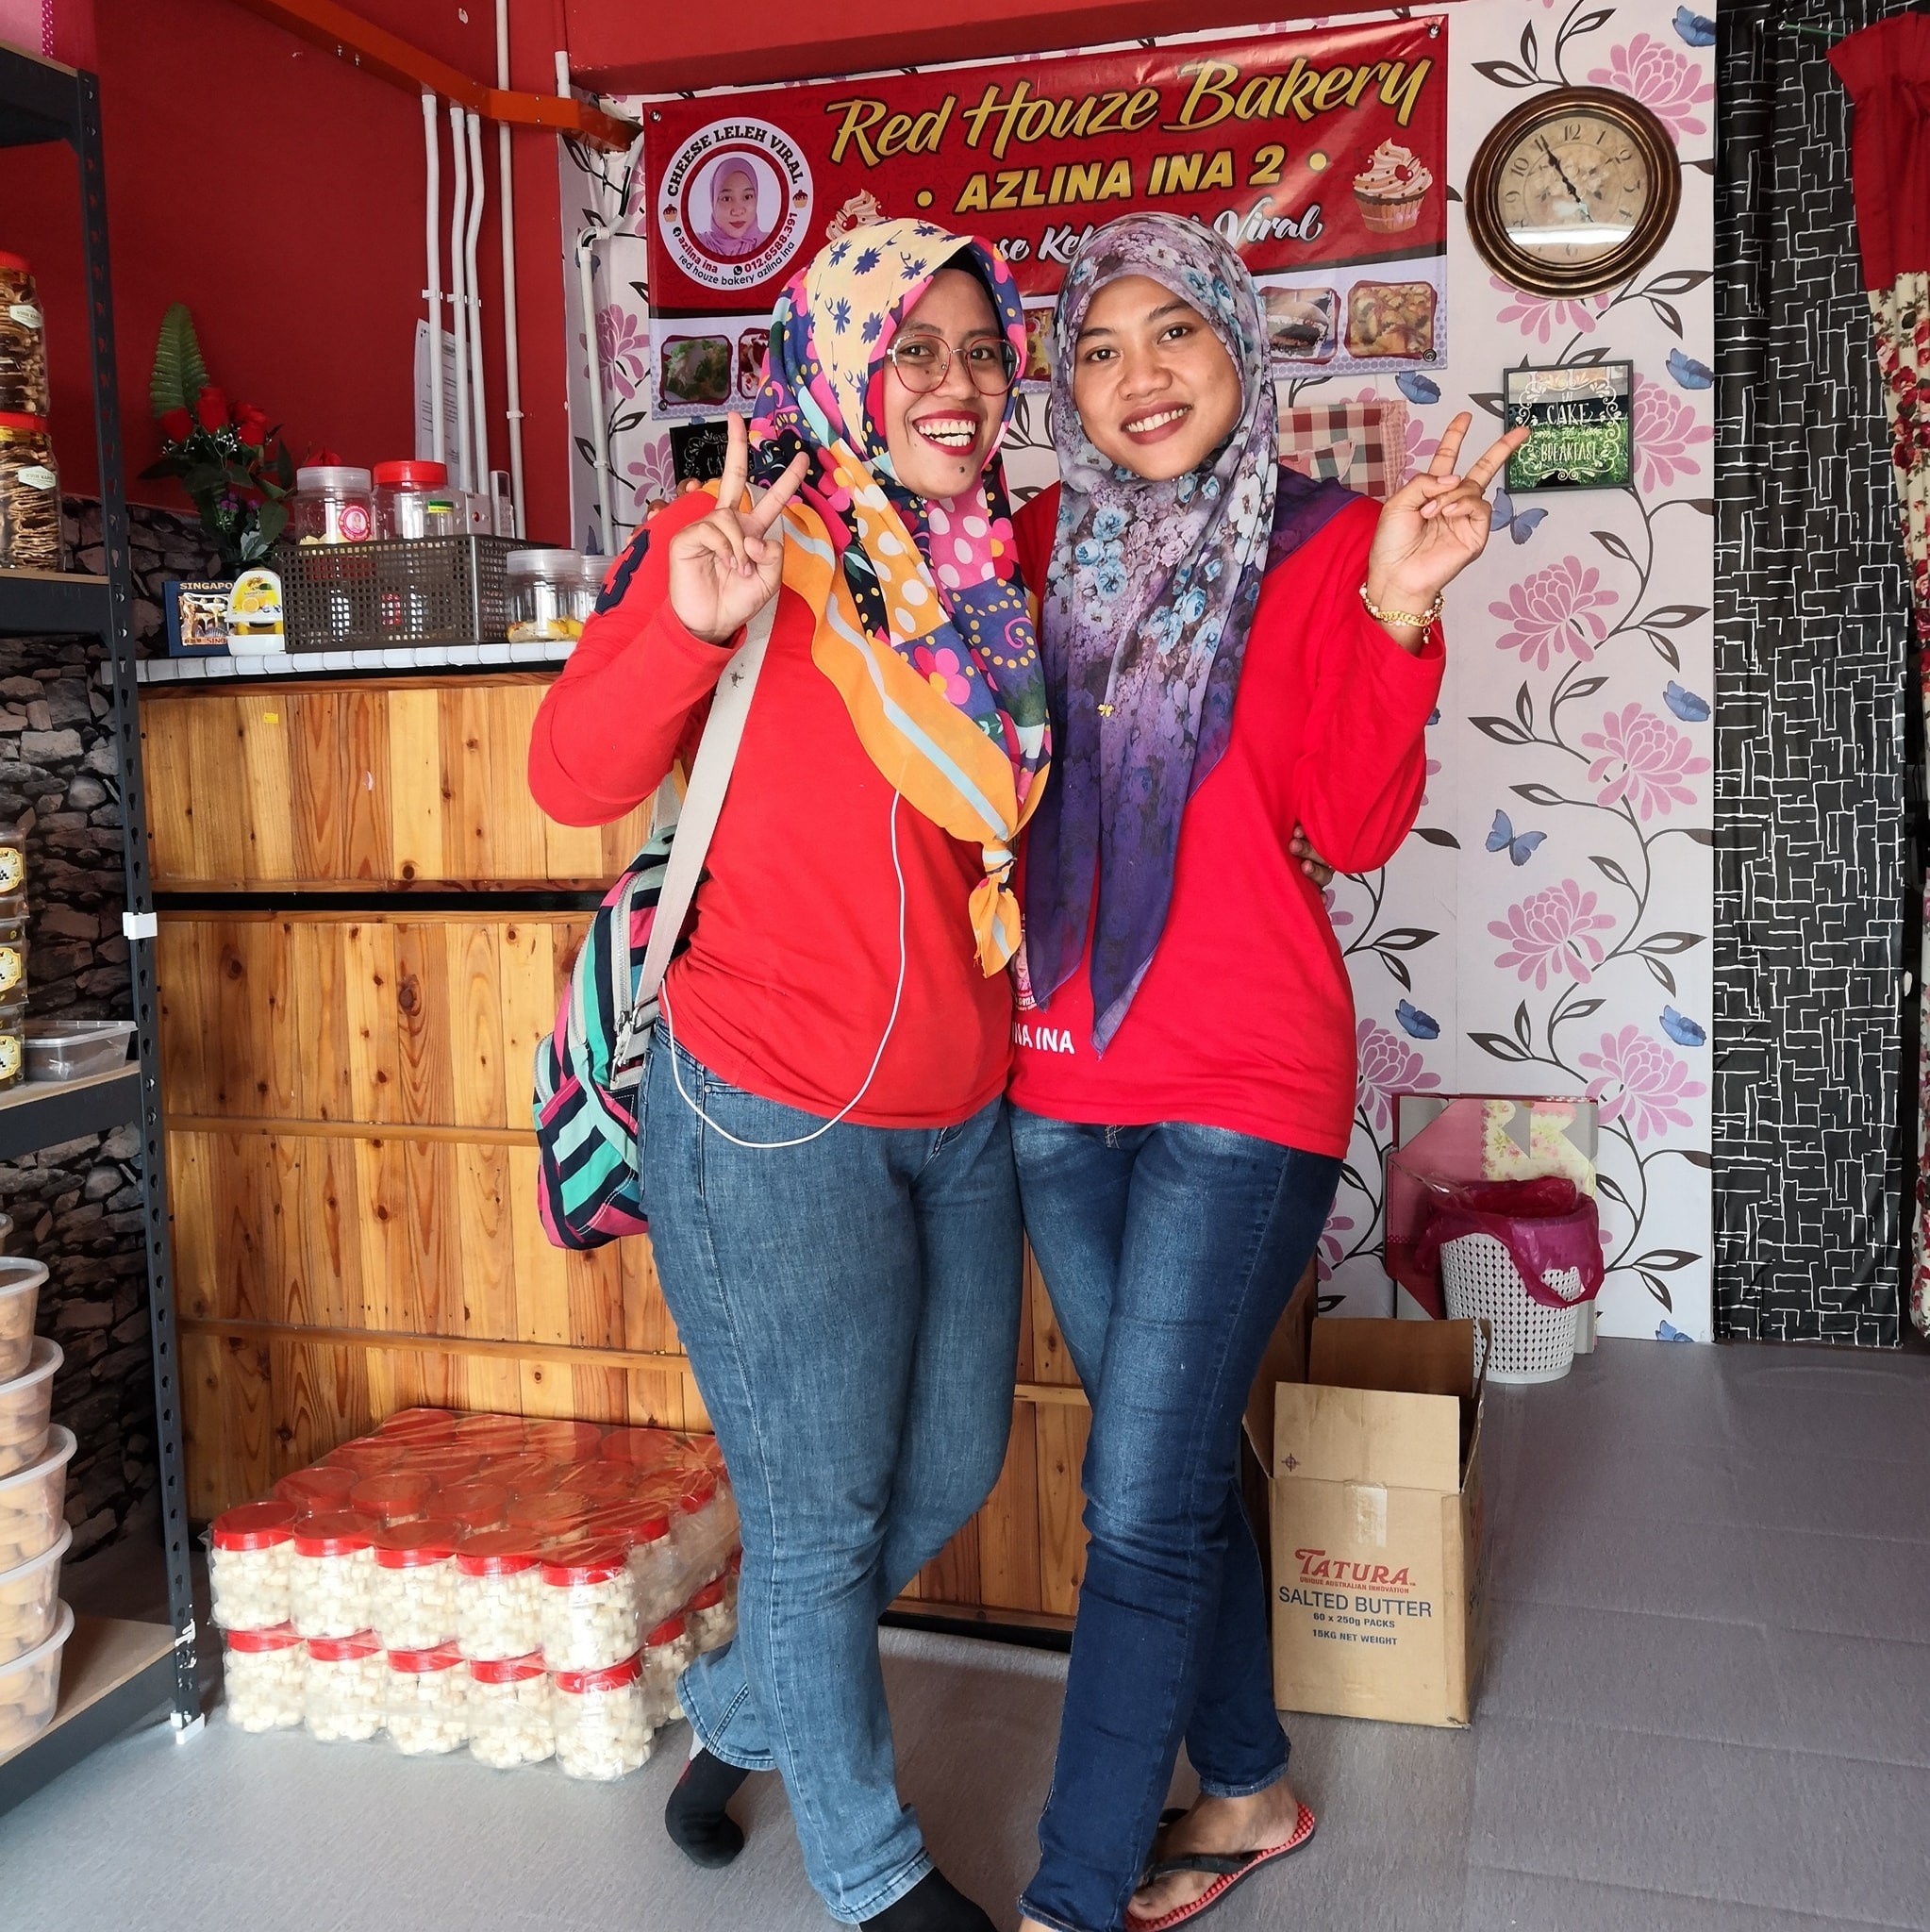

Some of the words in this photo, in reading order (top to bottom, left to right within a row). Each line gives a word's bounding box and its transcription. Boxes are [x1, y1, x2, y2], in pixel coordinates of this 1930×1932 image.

[826, 95, 957, 167] Red
[962, 80, 1158, 160] Houze
[1163, 58, 1432, 126] Bakery
[1564, 124, 1581, 141] 12
[667, 135, 712, 197] CHEESE
[713, 125, 768, 142] LELEH
[770, 134, 804, 185] VIRAL
[955, 159, 1132, 213] AZLINA
[1148, 150, 1233, 195] INA
[1249, 144, 1285, 186] 2
[1213, 196, 1323, 246] Viral
[678, 237, 702, 265] azlina
[702, 259, 718, 274] ina
[744, 212, 798, 273] 012.6588.391
[679, 255, 694, 270] red
[692, 265, 719, 284] houze
[721, 275, 755, 285] bakery
[757, 257, 783, 278] azlina
[780, 242, 795, 258] ina
[1547, 403, 1592, 425] CAKE
[1540, 441, 1596, 462] BREAKFAST
[179, 582, 233, 591] SINGAPO
[1012, 1021, 1034, 1048] NA
[1036, 1026, 1075, 1055] INA
[1294, 1548, 1410, 1586] TATURA
[1279, 1586, 1349, 1610] SALTED
[1356, 1596, 1432, 1618] BUTTER
[1300, 1576, 1324, 1586] UNIQUE
[1325, 1579, 1367, 1591] AUSTRALIAN
[1369, 1585, 1409, 1594] INNOVATION
[1313, 1612, 1325, 1621] 60
[1337, 1615, 1361, 1626] 250g
[1364, 1618, 1395, 1628] PACKS
[1313, 1629, 1337, 1640] 15KG
[1339, 1633, 1357, 1642] NET
[1360, 1636, 1398, 1646] WEIGHT
